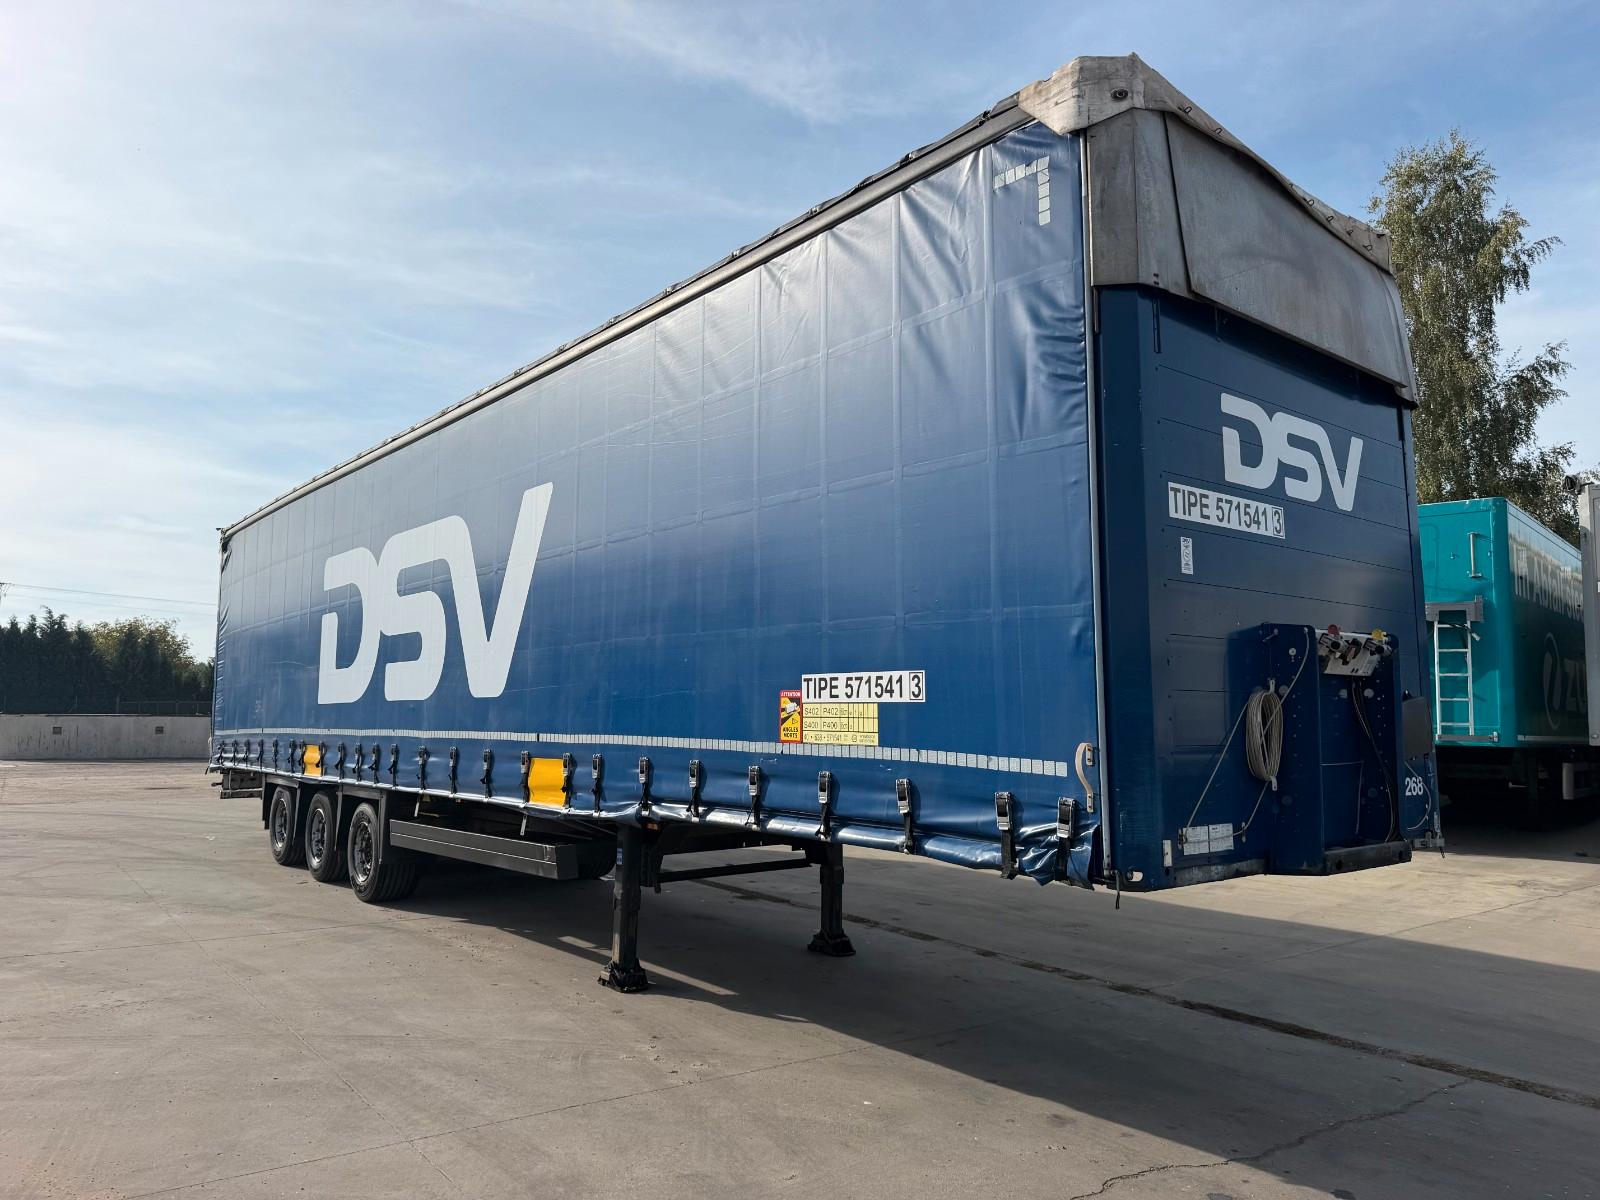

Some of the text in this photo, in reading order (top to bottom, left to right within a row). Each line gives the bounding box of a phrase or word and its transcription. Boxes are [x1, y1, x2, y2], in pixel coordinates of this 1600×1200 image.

[1220, 392, 1364, 512] DSV
[1169, 486, 1282, 535] TIPE 571541 3
[317, 481, 554, 705] DSV
[803, 674, 922, 699] TIPE 571541 3
[804, 707, 820, 716] S402
[822, 707, 839, 716] P402
[1405, 776, 1424, 796] 268
